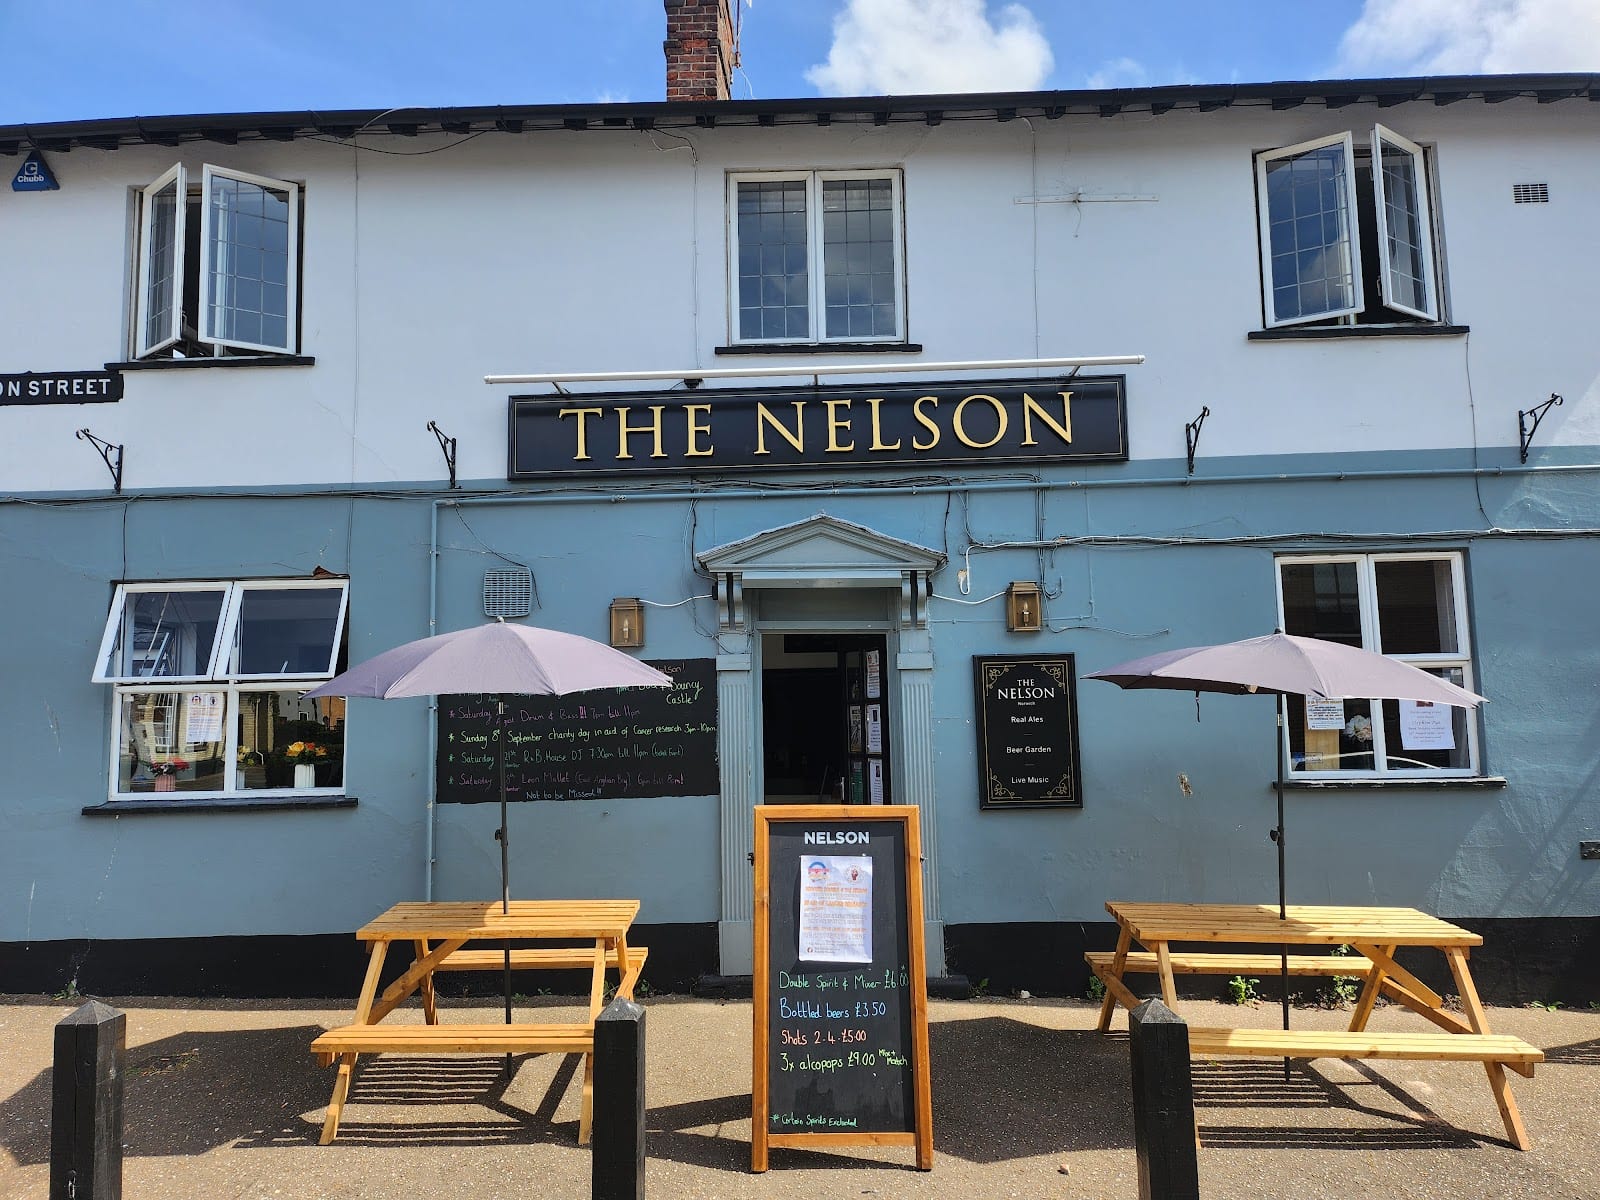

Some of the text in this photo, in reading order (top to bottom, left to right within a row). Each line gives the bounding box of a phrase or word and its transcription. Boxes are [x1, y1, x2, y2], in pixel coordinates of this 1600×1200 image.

[17, 174, 45, 183] Chubb
[28, 378, 111, 396] STREET
[557, 391, 1075, 461] THE NELSON
[1016, 679, 1035, 687] THE
[666, 693, 693, 705] Castle
[997, 687, 1055, 700] NELSON
[458, 706, 492, 725] Saturday
[460, 730, 488, 749] Sunday
[507, 730, 542, 746] September
[548, 728, 575, 742] charity
[577, 728, 590, 742] day
[604, 727, 617, 736] aid
[621, 726, 629, 738] of
[1006, 746, 1023, 754] Beer
[461, 752, 495, 769] Saturday
[1011, 776, 1026, 784] Live
[526, 791, 541, 799] Not
[543, 790, 552, 799] to
[804, 831, 870, 845] NELSON
[779, 971, 810, 989] Double
[816, 975, 839, 991] Spirit
[854, 974, 881, 990] Mixer
[780, 997, 823, 1019] Bottled
[826, 1002, 850, 1019] beers
[781, 1029, 807, 1046] Shots
[779, 1052, 795, 1072] 3x
[799, 1054, 844, 1074] alcopops
[805, 1114, 827, 1126] Spirits
